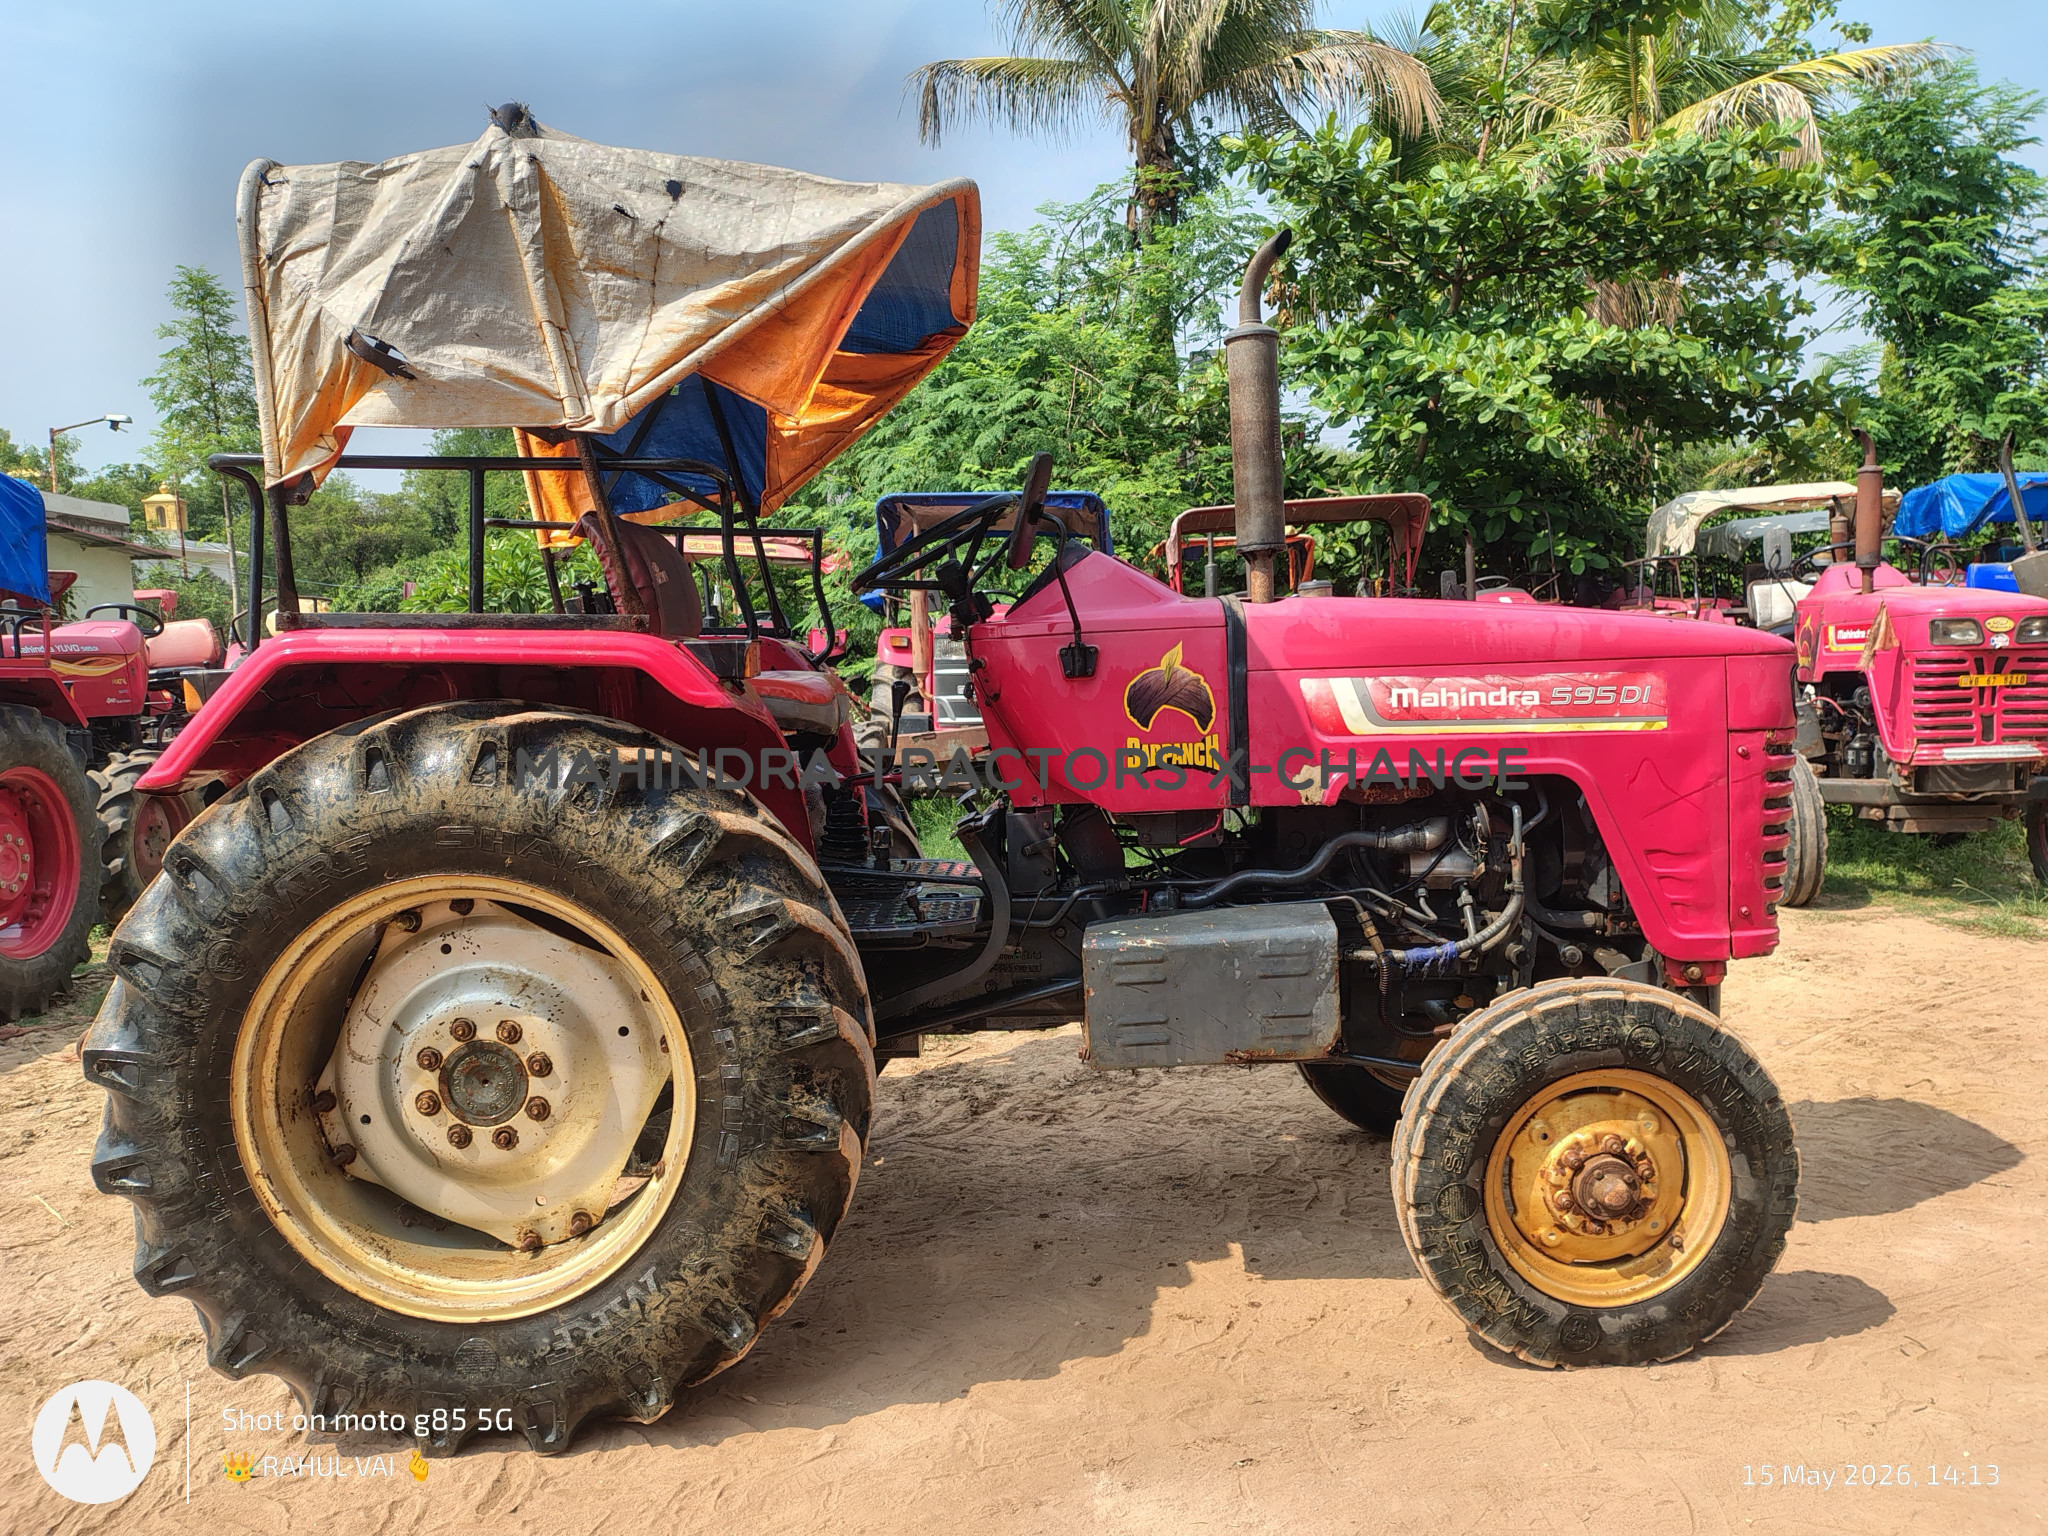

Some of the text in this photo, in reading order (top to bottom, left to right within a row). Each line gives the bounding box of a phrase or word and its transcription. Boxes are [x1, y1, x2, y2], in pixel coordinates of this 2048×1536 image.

[55, 643, 79, 653] YUVO
[1986, 675, 1996, 685] 67
[1390, 686, 1540, 708] Mahindra
[241, 832, 374, 935] MRF
